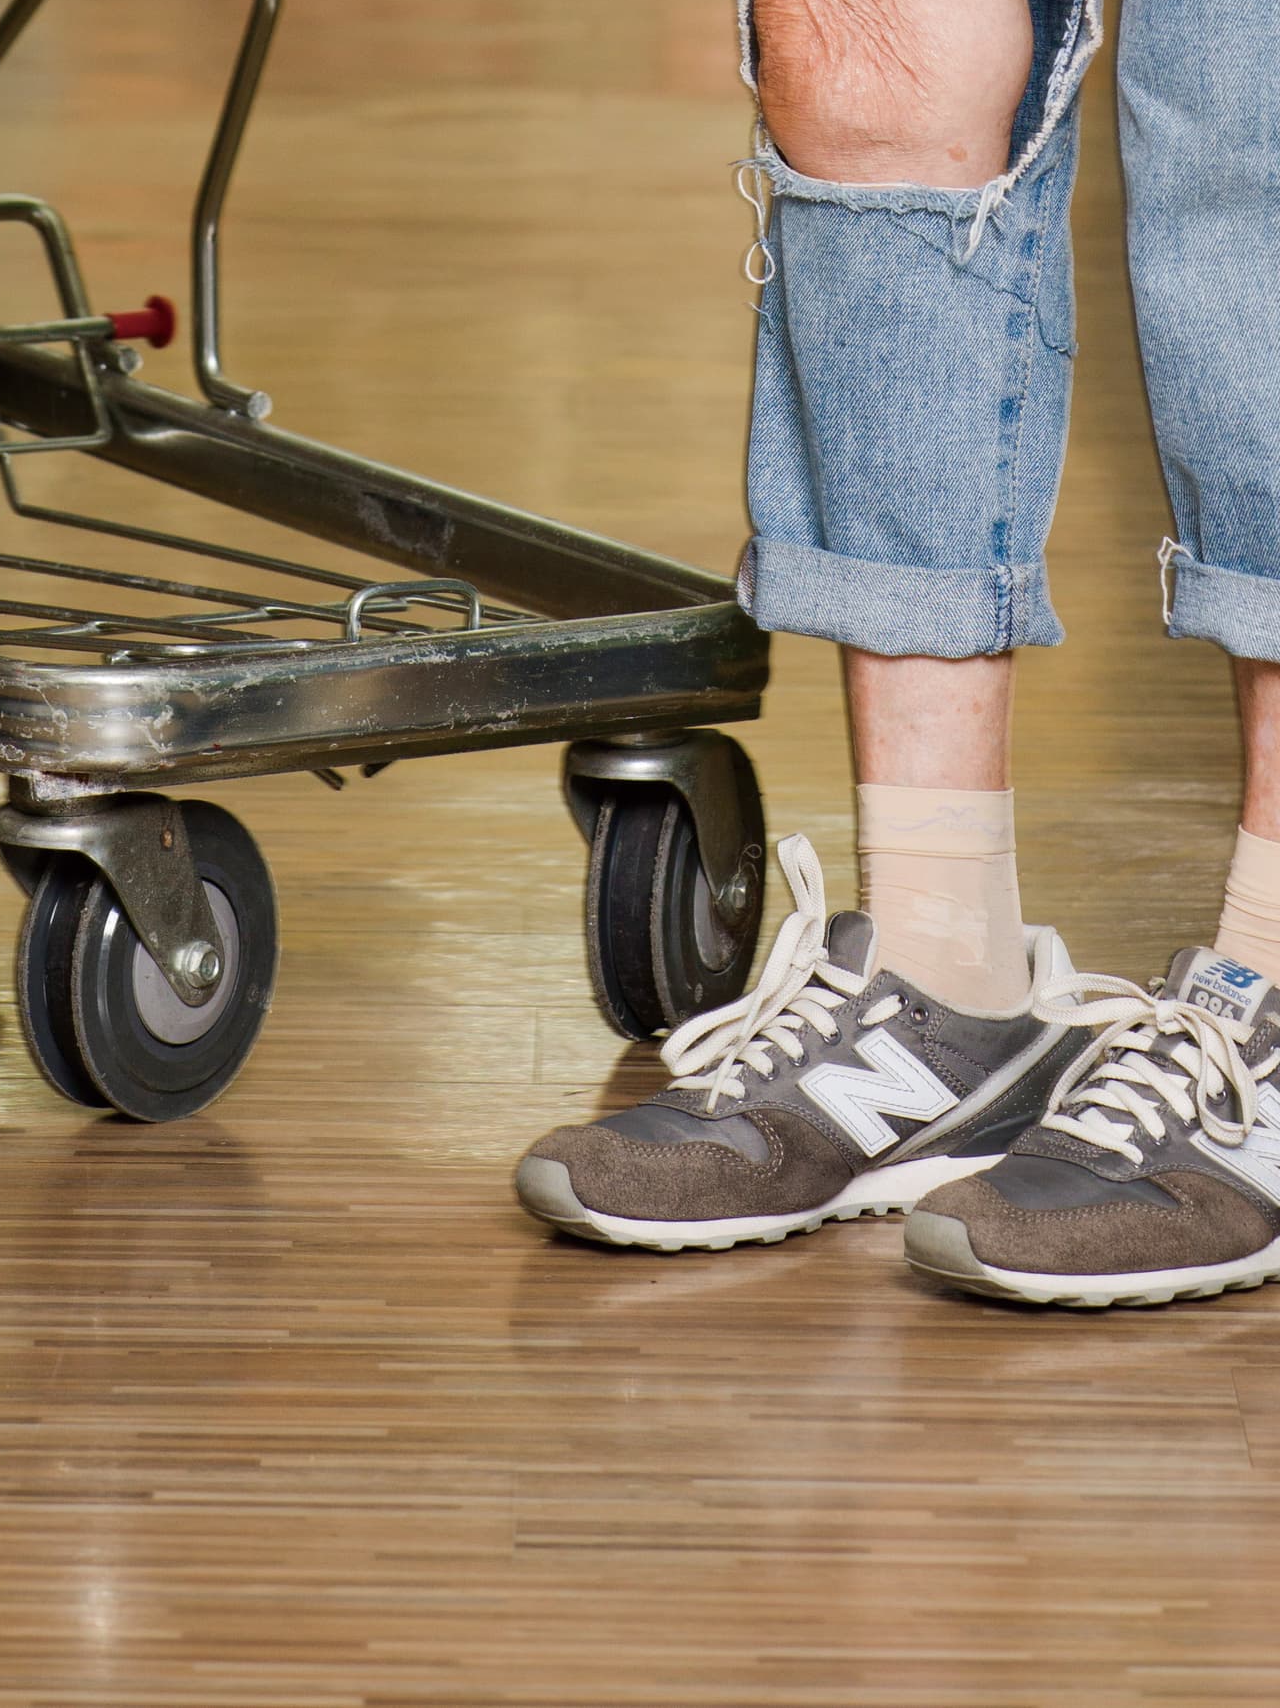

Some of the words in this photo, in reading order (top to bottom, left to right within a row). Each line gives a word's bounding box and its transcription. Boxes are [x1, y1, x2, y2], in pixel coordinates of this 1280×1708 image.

[1191, 971, 1213, 987] new
[1212, 979, 1253, 1006] balance
[797, 1027, 961, 1158] N
